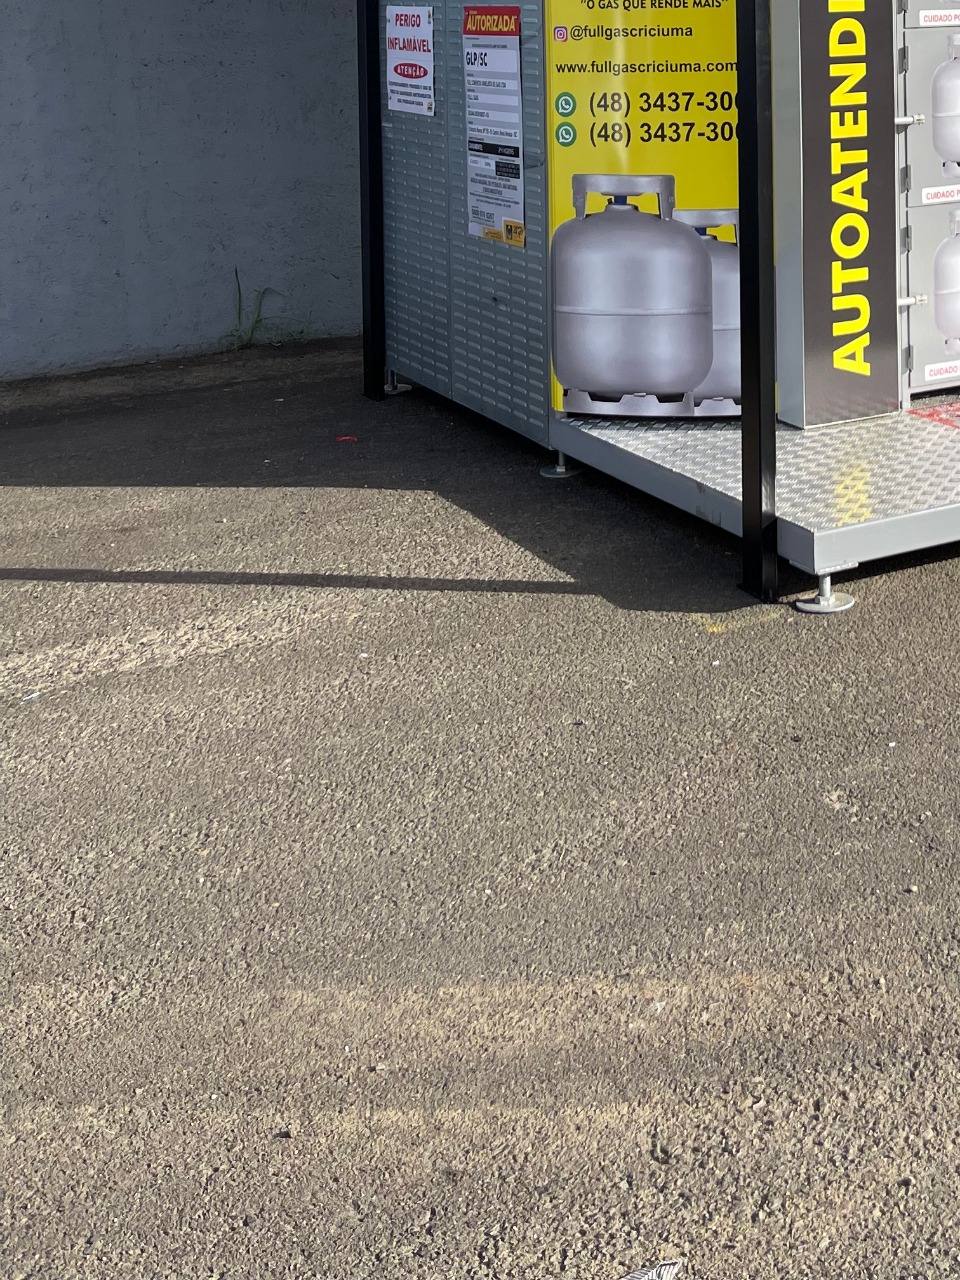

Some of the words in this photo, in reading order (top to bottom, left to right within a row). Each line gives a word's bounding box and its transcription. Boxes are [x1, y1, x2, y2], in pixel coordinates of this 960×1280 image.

[395, 13, 421, 28] PERIGO
[466, 14, 516, 32] AUTORIZADA
[924, 14, 952, 23] CUIDADO
[570, 25, 694, 41] @fullgascriciuma
[387, 35, 432, 53] INFLAMÁVEL
[466, 51, 488, 67] GLP/SC
[555, 60, 738, 76] www.fullgascriciuma.com
[589, 91, 631, 118] (48)
[589, 121, 632, 148] (48)
[926, 191, 955, 200] CUIDADO
[929, 366, 958, 377] CUIDADO
